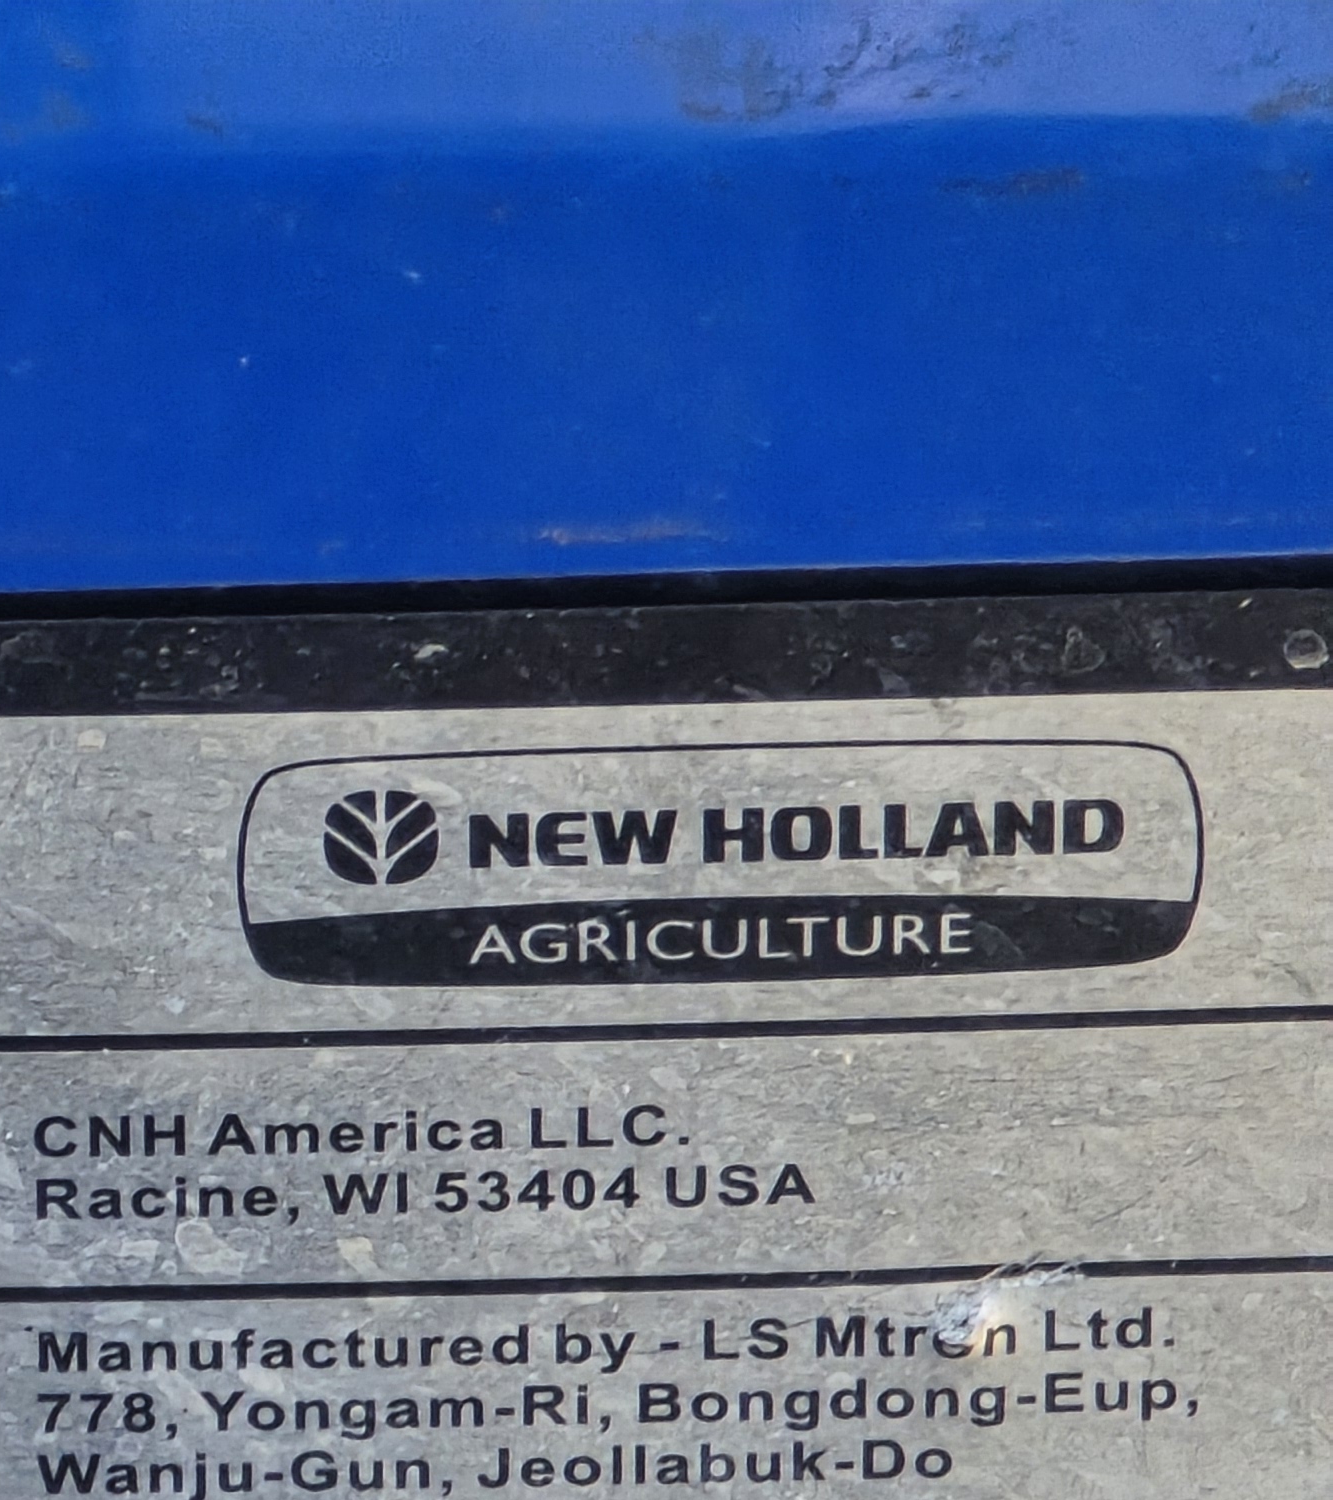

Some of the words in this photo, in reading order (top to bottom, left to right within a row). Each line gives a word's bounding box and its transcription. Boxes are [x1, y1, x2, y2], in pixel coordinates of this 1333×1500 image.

[468, 810, 678, 869] NEW
[701, 797, 1126, 865] HOLLAND
[468, 909, 973, 965] AGRICULTURE
[33, 1113, 186, 1158] CNH
[207, 1110, 504, 1155] America
[530, 1104, 690, 1149] LLC.
[35, 1176, 300, 1226] Racine,
[322, 1172, 409, 1216] WI
[433, 1166, 640, 1214] 53404
[665, 1163, 816, 1208] USA
[37, 1323, 530, 1373] Manufactured
[555, 1322, 637, 1374] by
[702, 1316, 789, 1361] LS
[1044, 1306, 1177, 1352] Ltd.
[37, 1391, 178, 1441] 778,
[201, 1383, 612, 1441] Yongam-Ri,
[637, 1371, 1199, 1431] Bongdong-Eup,
[477, 1439, 954, 1489] Jeollabuk-Do
